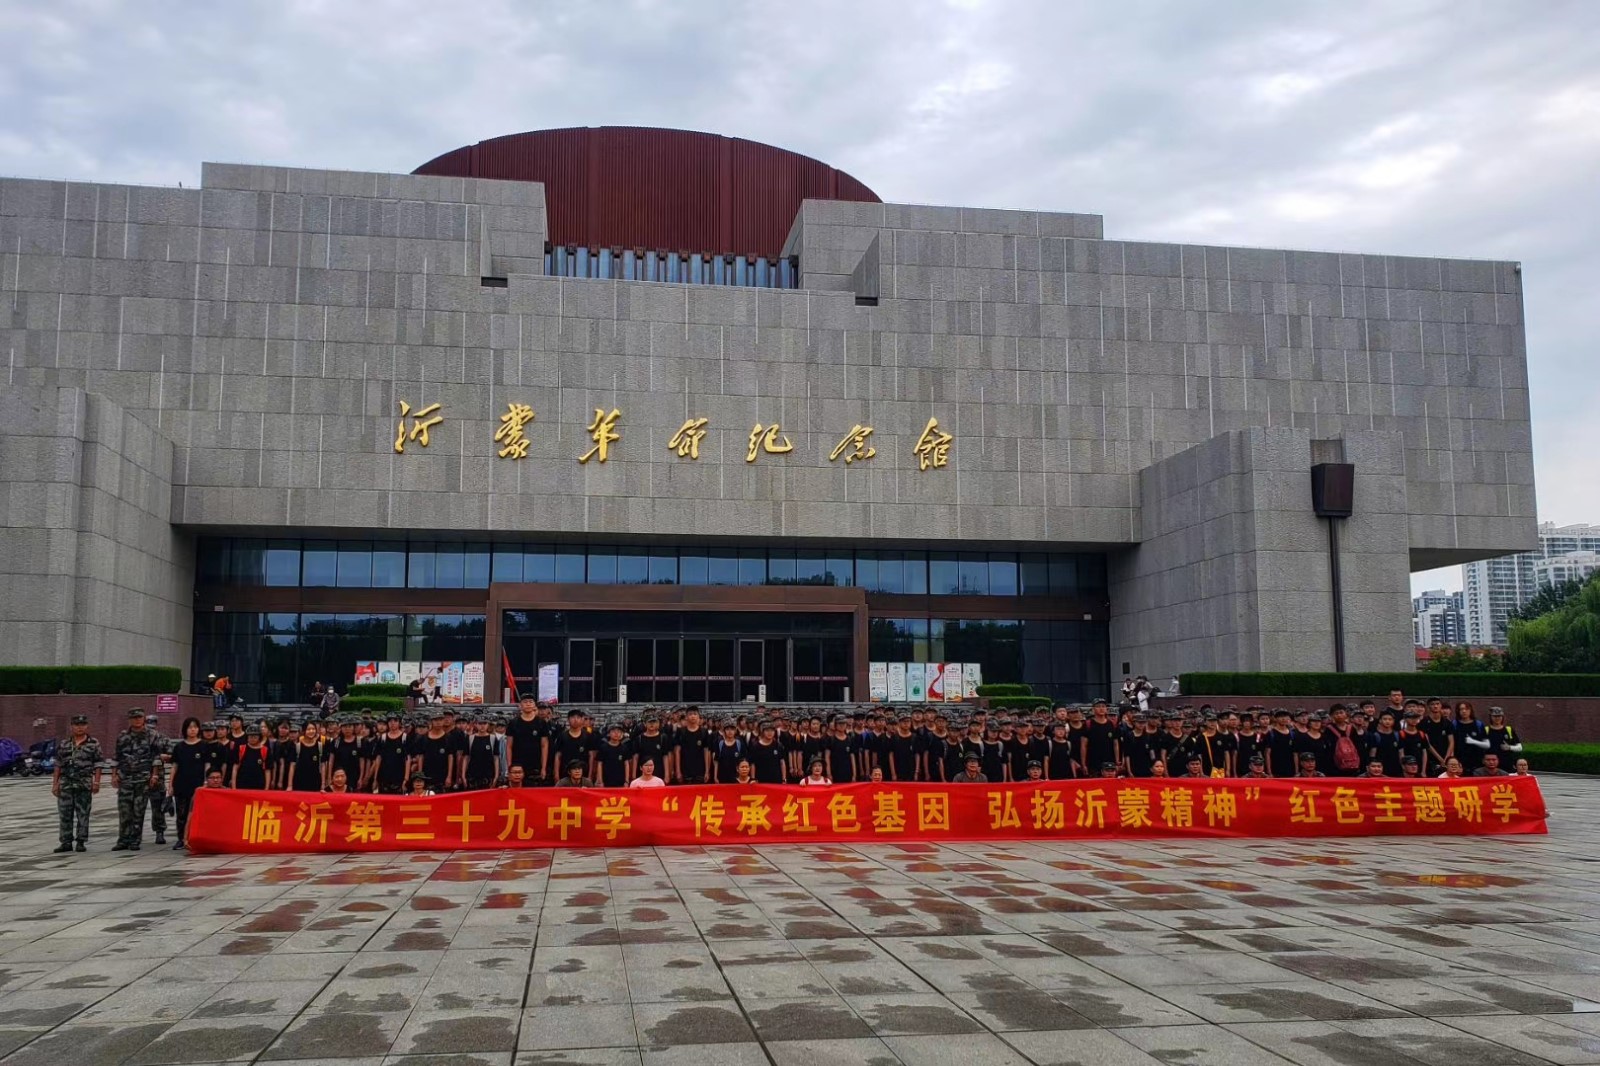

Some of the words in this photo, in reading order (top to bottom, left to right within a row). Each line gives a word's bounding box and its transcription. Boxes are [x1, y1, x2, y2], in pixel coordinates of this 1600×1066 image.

[242, 797, 632, 844] 临沂第三十九中学
[1290, 784, 1519, 824] 红色主题研学
